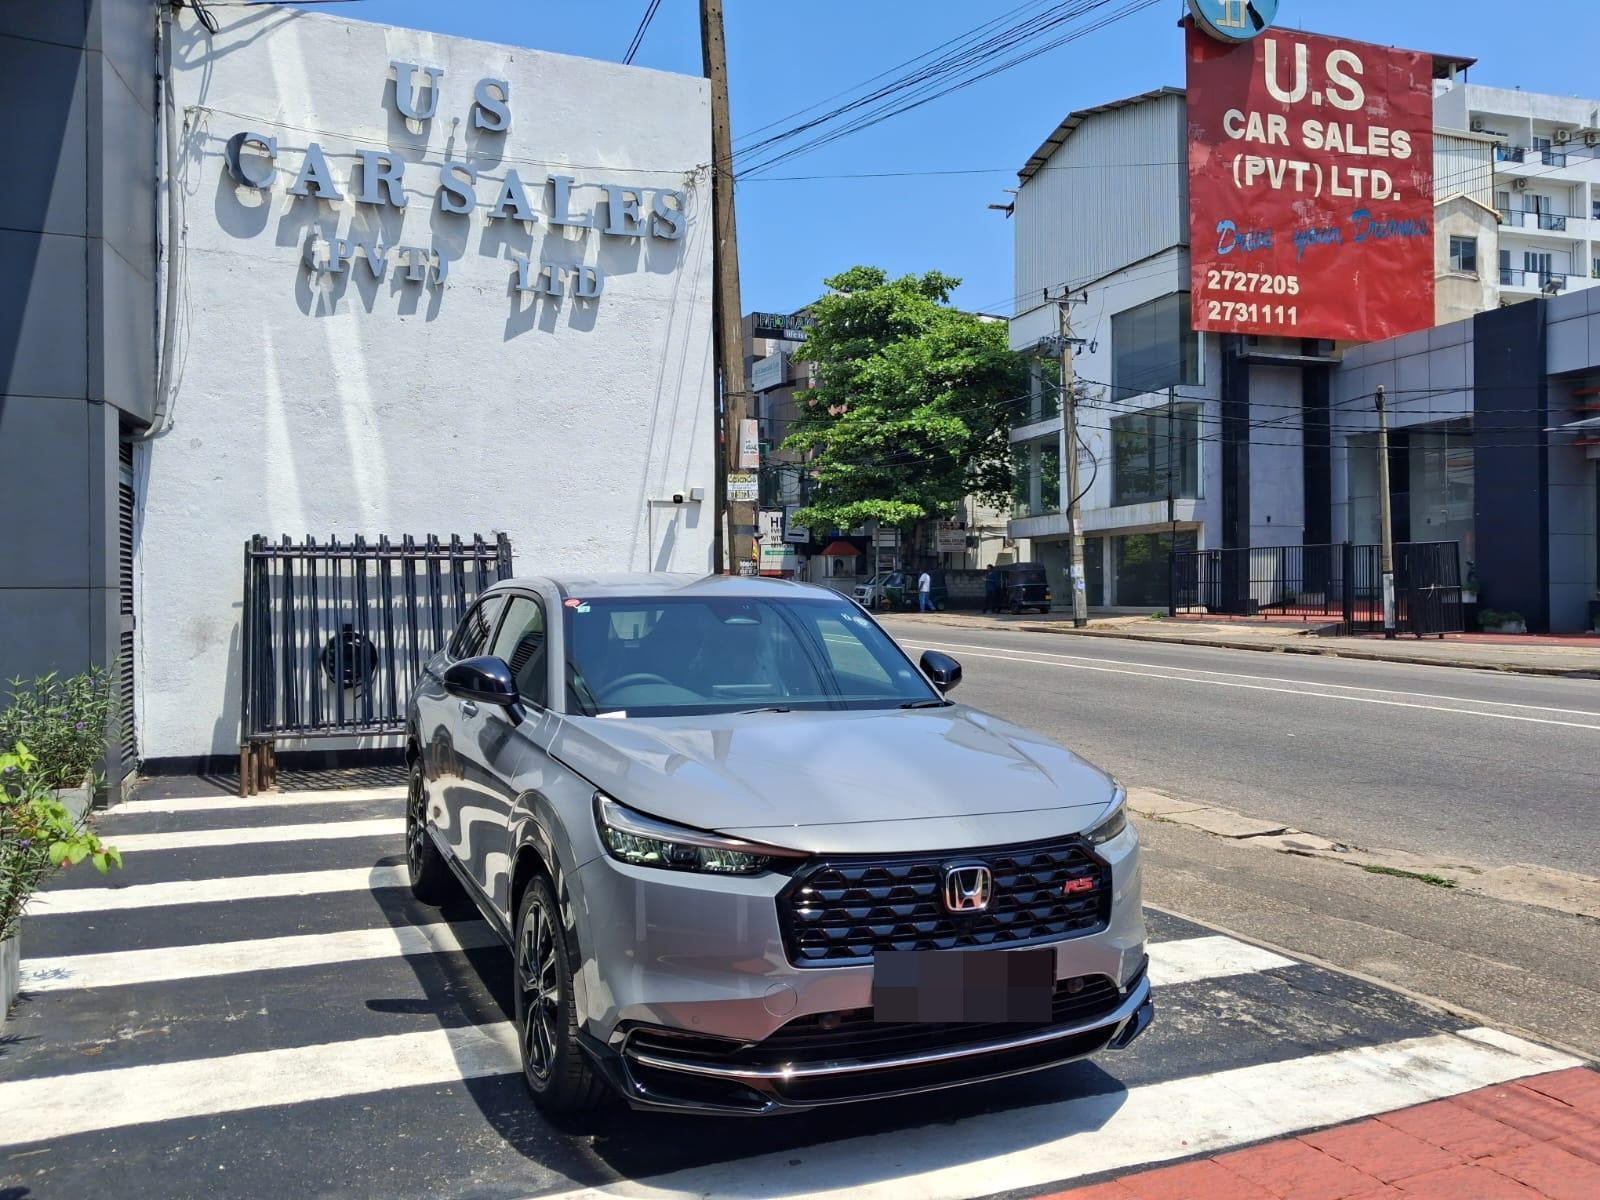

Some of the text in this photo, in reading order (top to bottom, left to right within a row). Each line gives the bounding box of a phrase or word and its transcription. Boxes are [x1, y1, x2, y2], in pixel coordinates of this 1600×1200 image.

[1263, 38, 1365, 111] U.S
[1223, 108, 1412, 160] CAR SALES
[224, 131, 686, 241] CAR SALES
[1232, 153, 1401, 201] (PVT) LTD.
[515, 256, 601, 299] LTD
[1207, 269, 1300, 296] 2727205
[1207, 300, 1298, 326] 2731111
[1063, 877, 1093, 894] RS
